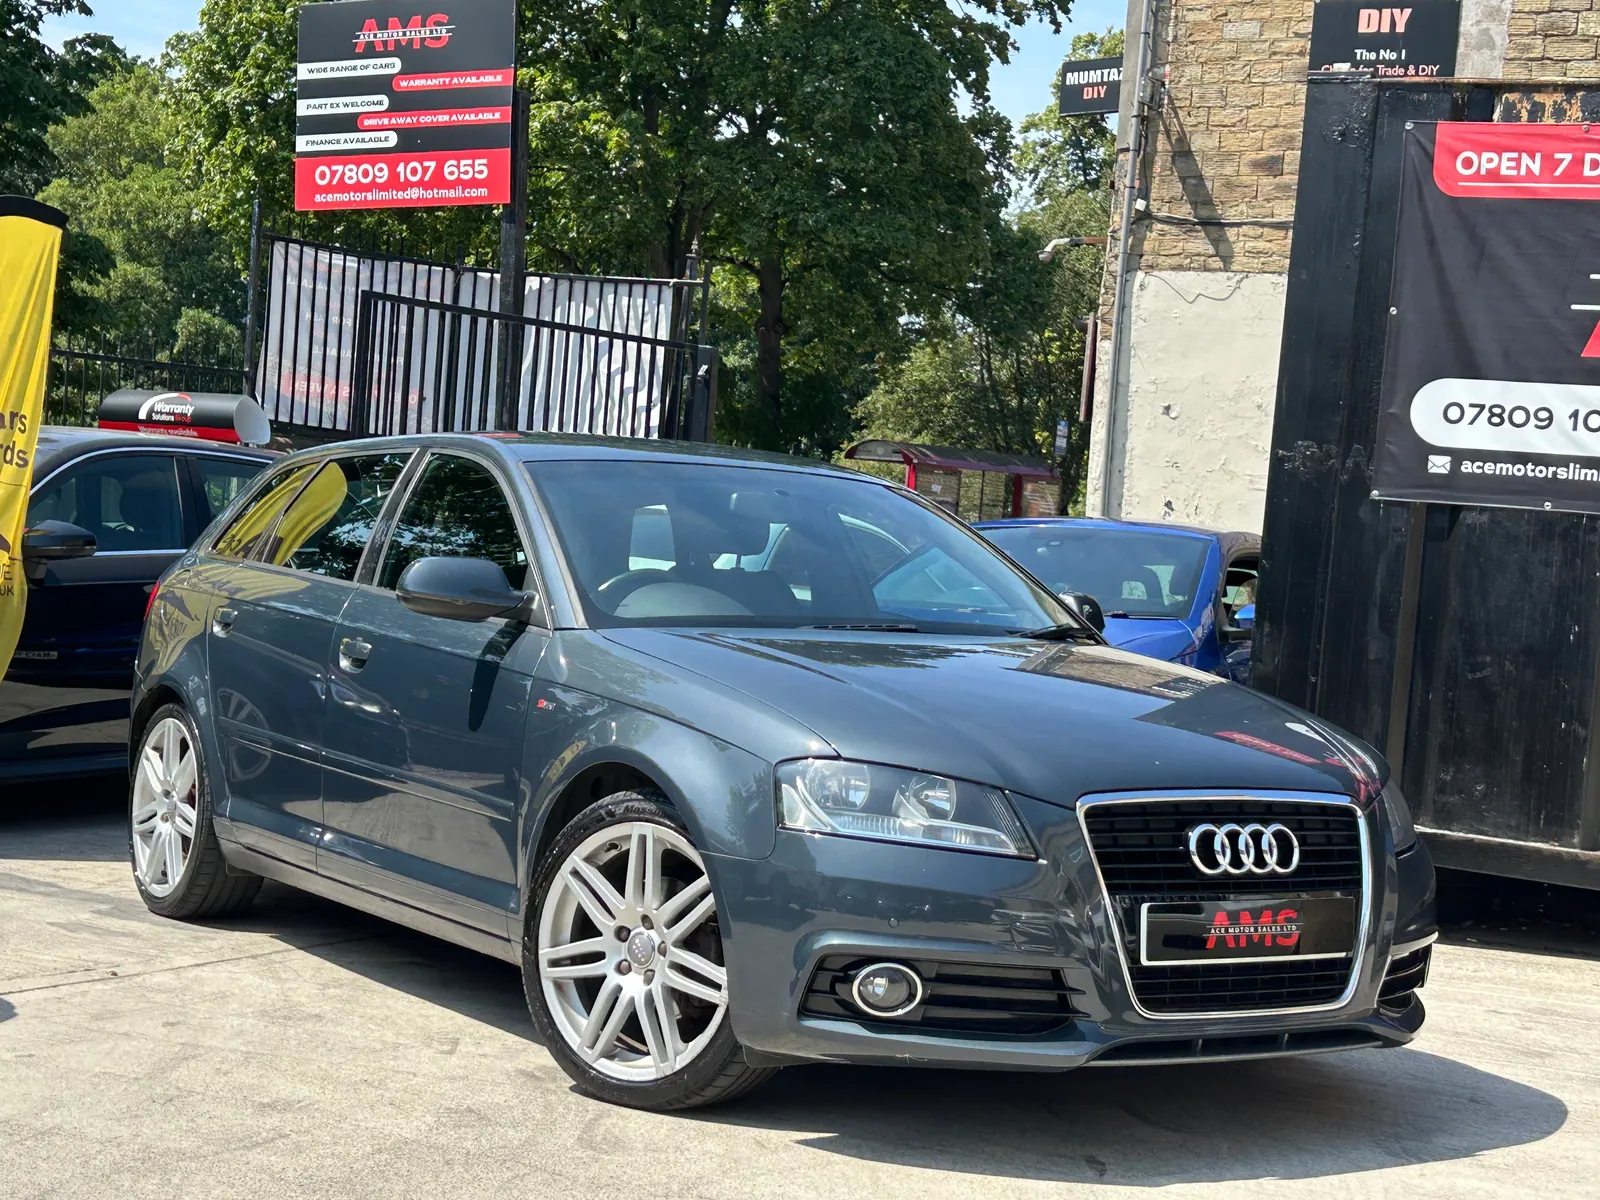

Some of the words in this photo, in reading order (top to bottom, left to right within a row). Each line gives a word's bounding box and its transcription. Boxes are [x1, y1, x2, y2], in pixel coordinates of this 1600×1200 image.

[1358, 8, 1412, 33] DIY
[355, 13, 449, 52] AMS
[377, 31, 403, 39] MOTOR
[406, 29, 430, 37] SALES
[1355, 48, 1376, 60] The
[1380, 49, 1397, 60] No
[329, 65, 358, 73] RANGE
[372, 62, 396, 70] CARS
[1376, 64, 1404, 76] Trade
[1407, 65, 1416, 76] &
[1418, 65, 1440, 76] DIY
[400, 78, 450, 87] WARRANTY
[452, 75, 502, 85] AVAILABLE
[1083, 85, 1107, 100] DIY
[342, 100, 384, 108] WELCOME
[364, 117, 389, 125] DRIVE
[390, 116, 418, 125] AWAY
[419, 114, 449, 123] COVER
[451, 112, 500, 121] AVAILABLE
[306, 138, 341, 146] FINANCE
[343, 136, 389, 144] AVAILABLE
[1456, 151, 1541, 176] OPEN
[1553, 153, 1573, 176] 7
[315, 163, 389, 185] 07809
[396, 161, 436, 182] 107
[444, 159, 488, 181] 655
[314, 186, 488, 203] acemotorslimited@hotmail.com
[153, 401, 195, 417] Warranty
[1443, 401, 1553, 430] 07809
[1206, 909, 1300, 949] AMS
